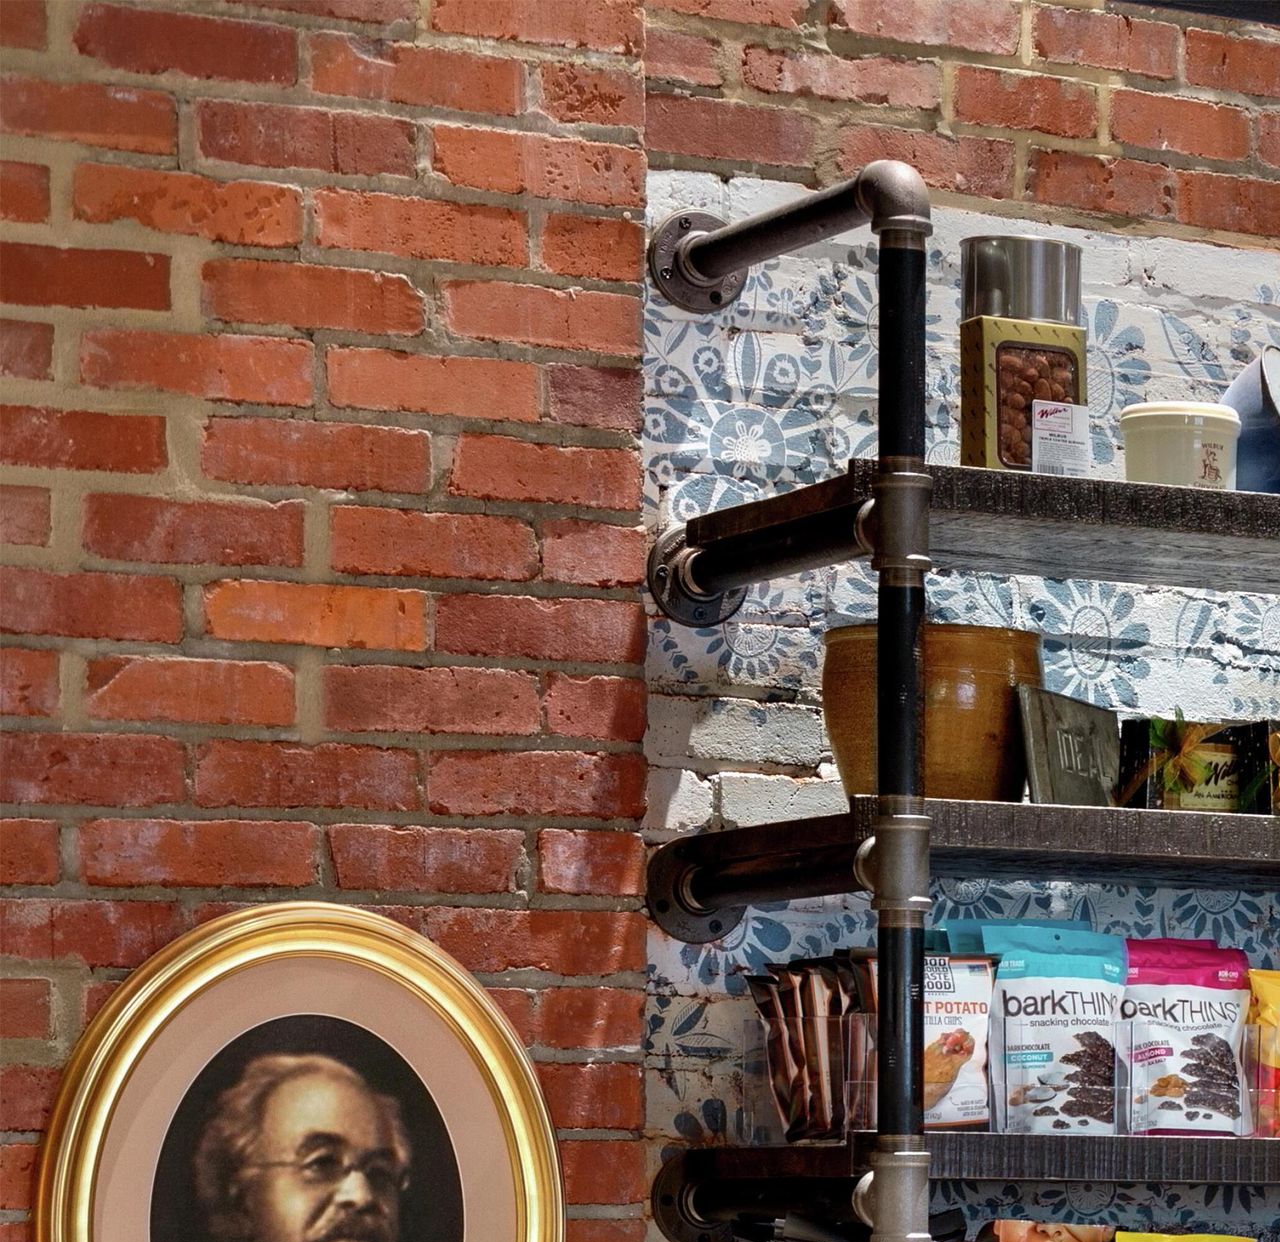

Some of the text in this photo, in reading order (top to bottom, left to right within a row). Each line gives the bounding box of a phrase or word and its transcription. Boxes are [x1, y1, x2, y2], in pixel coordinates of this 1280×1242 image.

[935, 1001, 988, 1015] POTATO
[1030, 1018, 1110, 1028] snacking chocolate
[1182, 1023, 1223, 1031] chocolate
[1010, 1054, 1048, 1062] COCONUT
